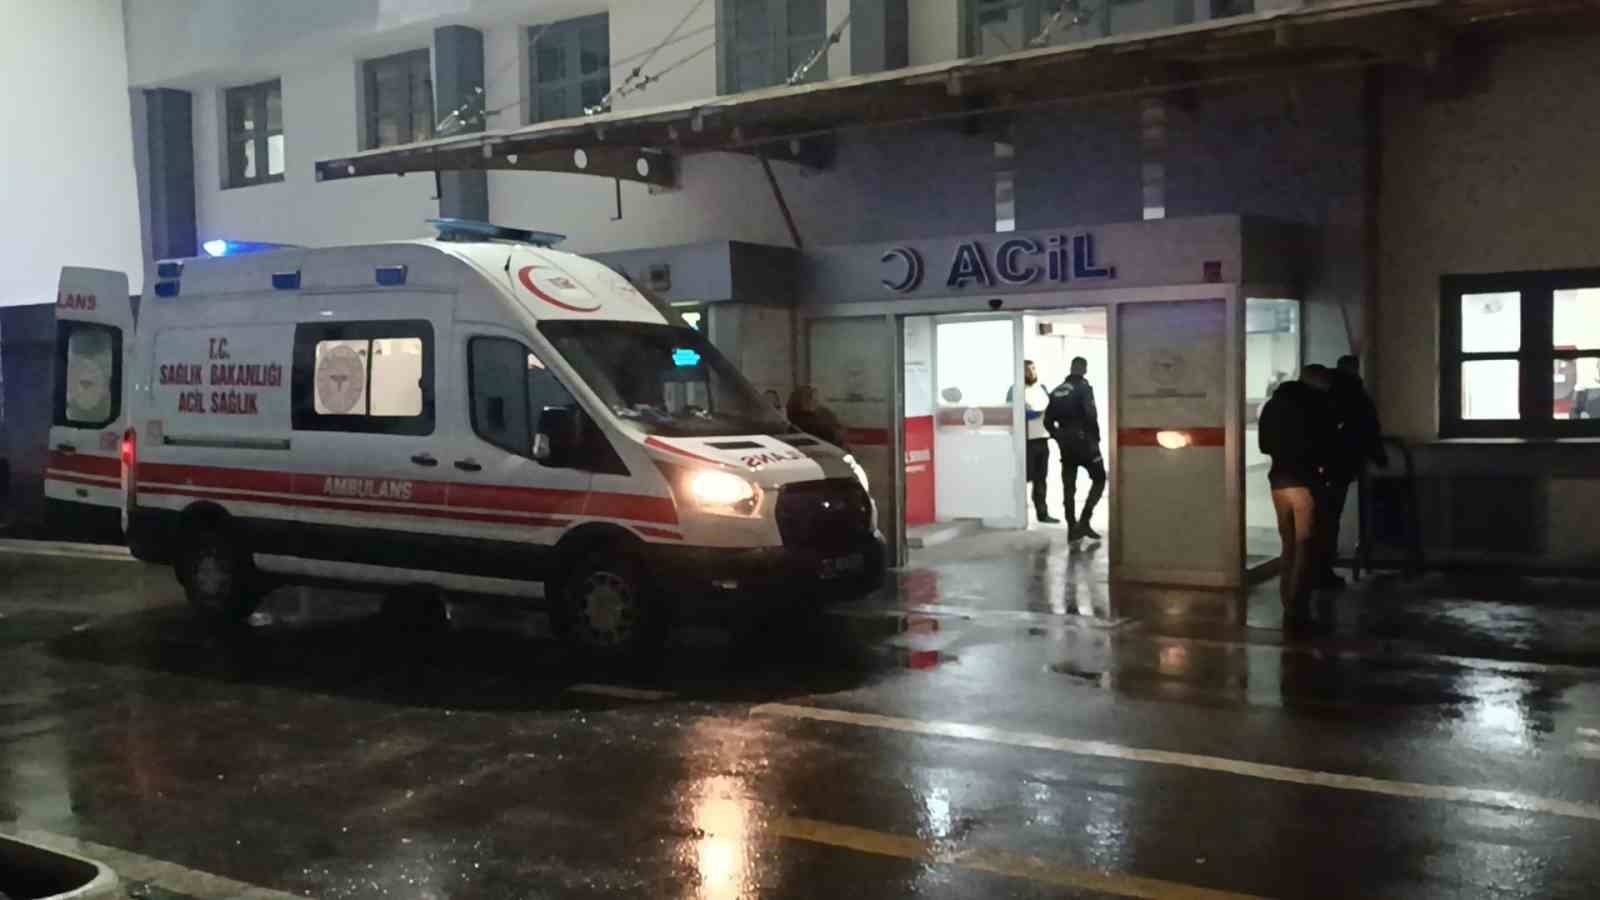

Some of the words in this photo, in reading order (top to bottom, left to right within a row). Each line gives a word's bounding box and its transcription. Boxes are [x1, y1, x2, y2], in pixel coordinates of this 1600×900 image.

[208, 337, 231, 360] T.C.
[159, 363, 203, 385] SAĞLIK
[209, 362, 282, 387] BAKANLIĞI
[210, 389, 258, 415] SAĞLIK
[322, 475, 414, 501] AMBULANS
